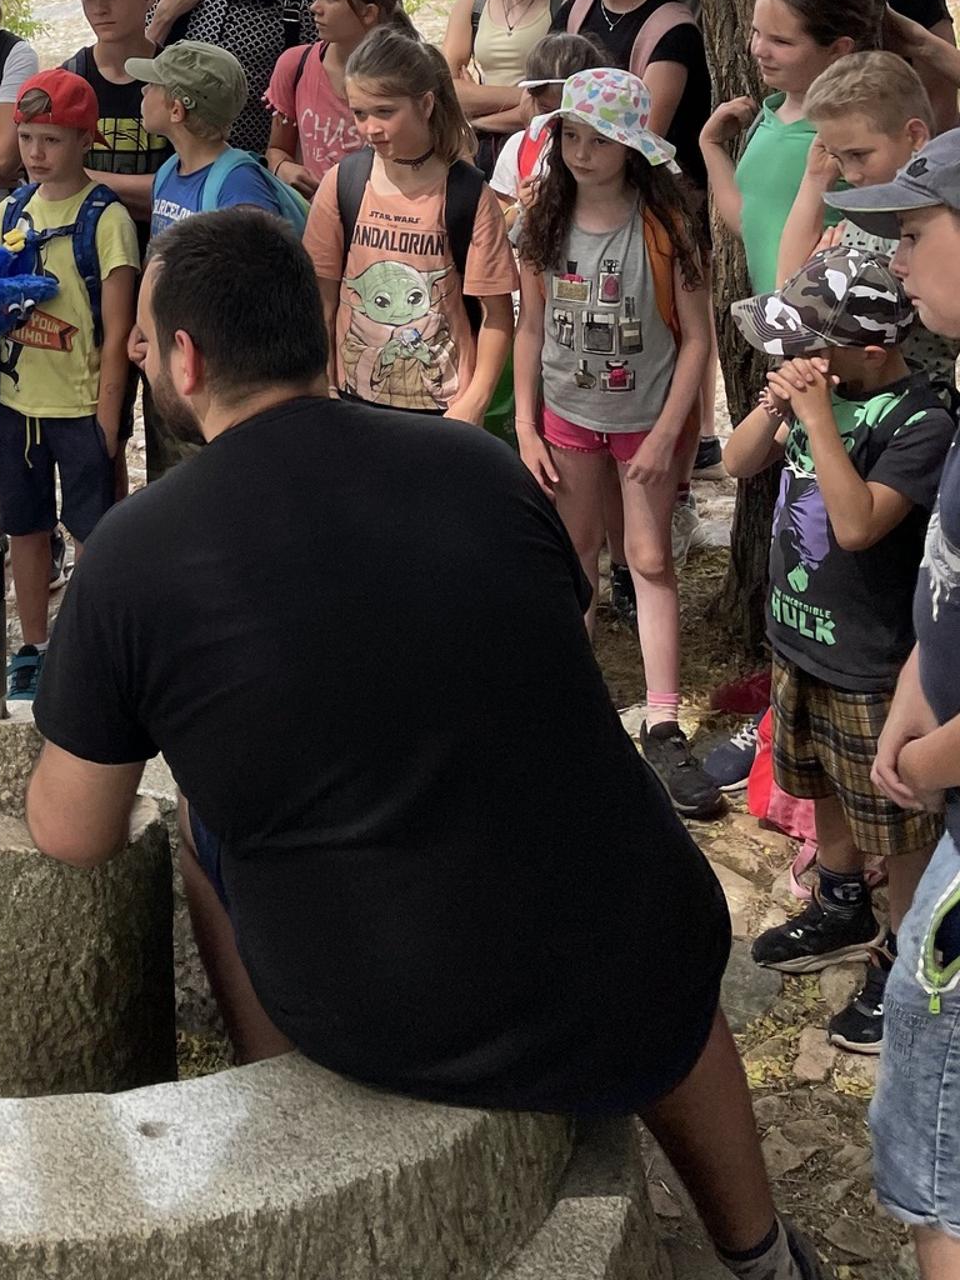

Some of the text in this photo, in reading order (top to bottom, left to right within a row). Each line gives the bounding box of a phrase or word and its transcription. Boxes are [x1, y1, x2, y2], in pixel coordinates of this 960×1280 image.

[369, 210, 421, 224] STAR WARS
[771, 592, 837, 646] HULK
